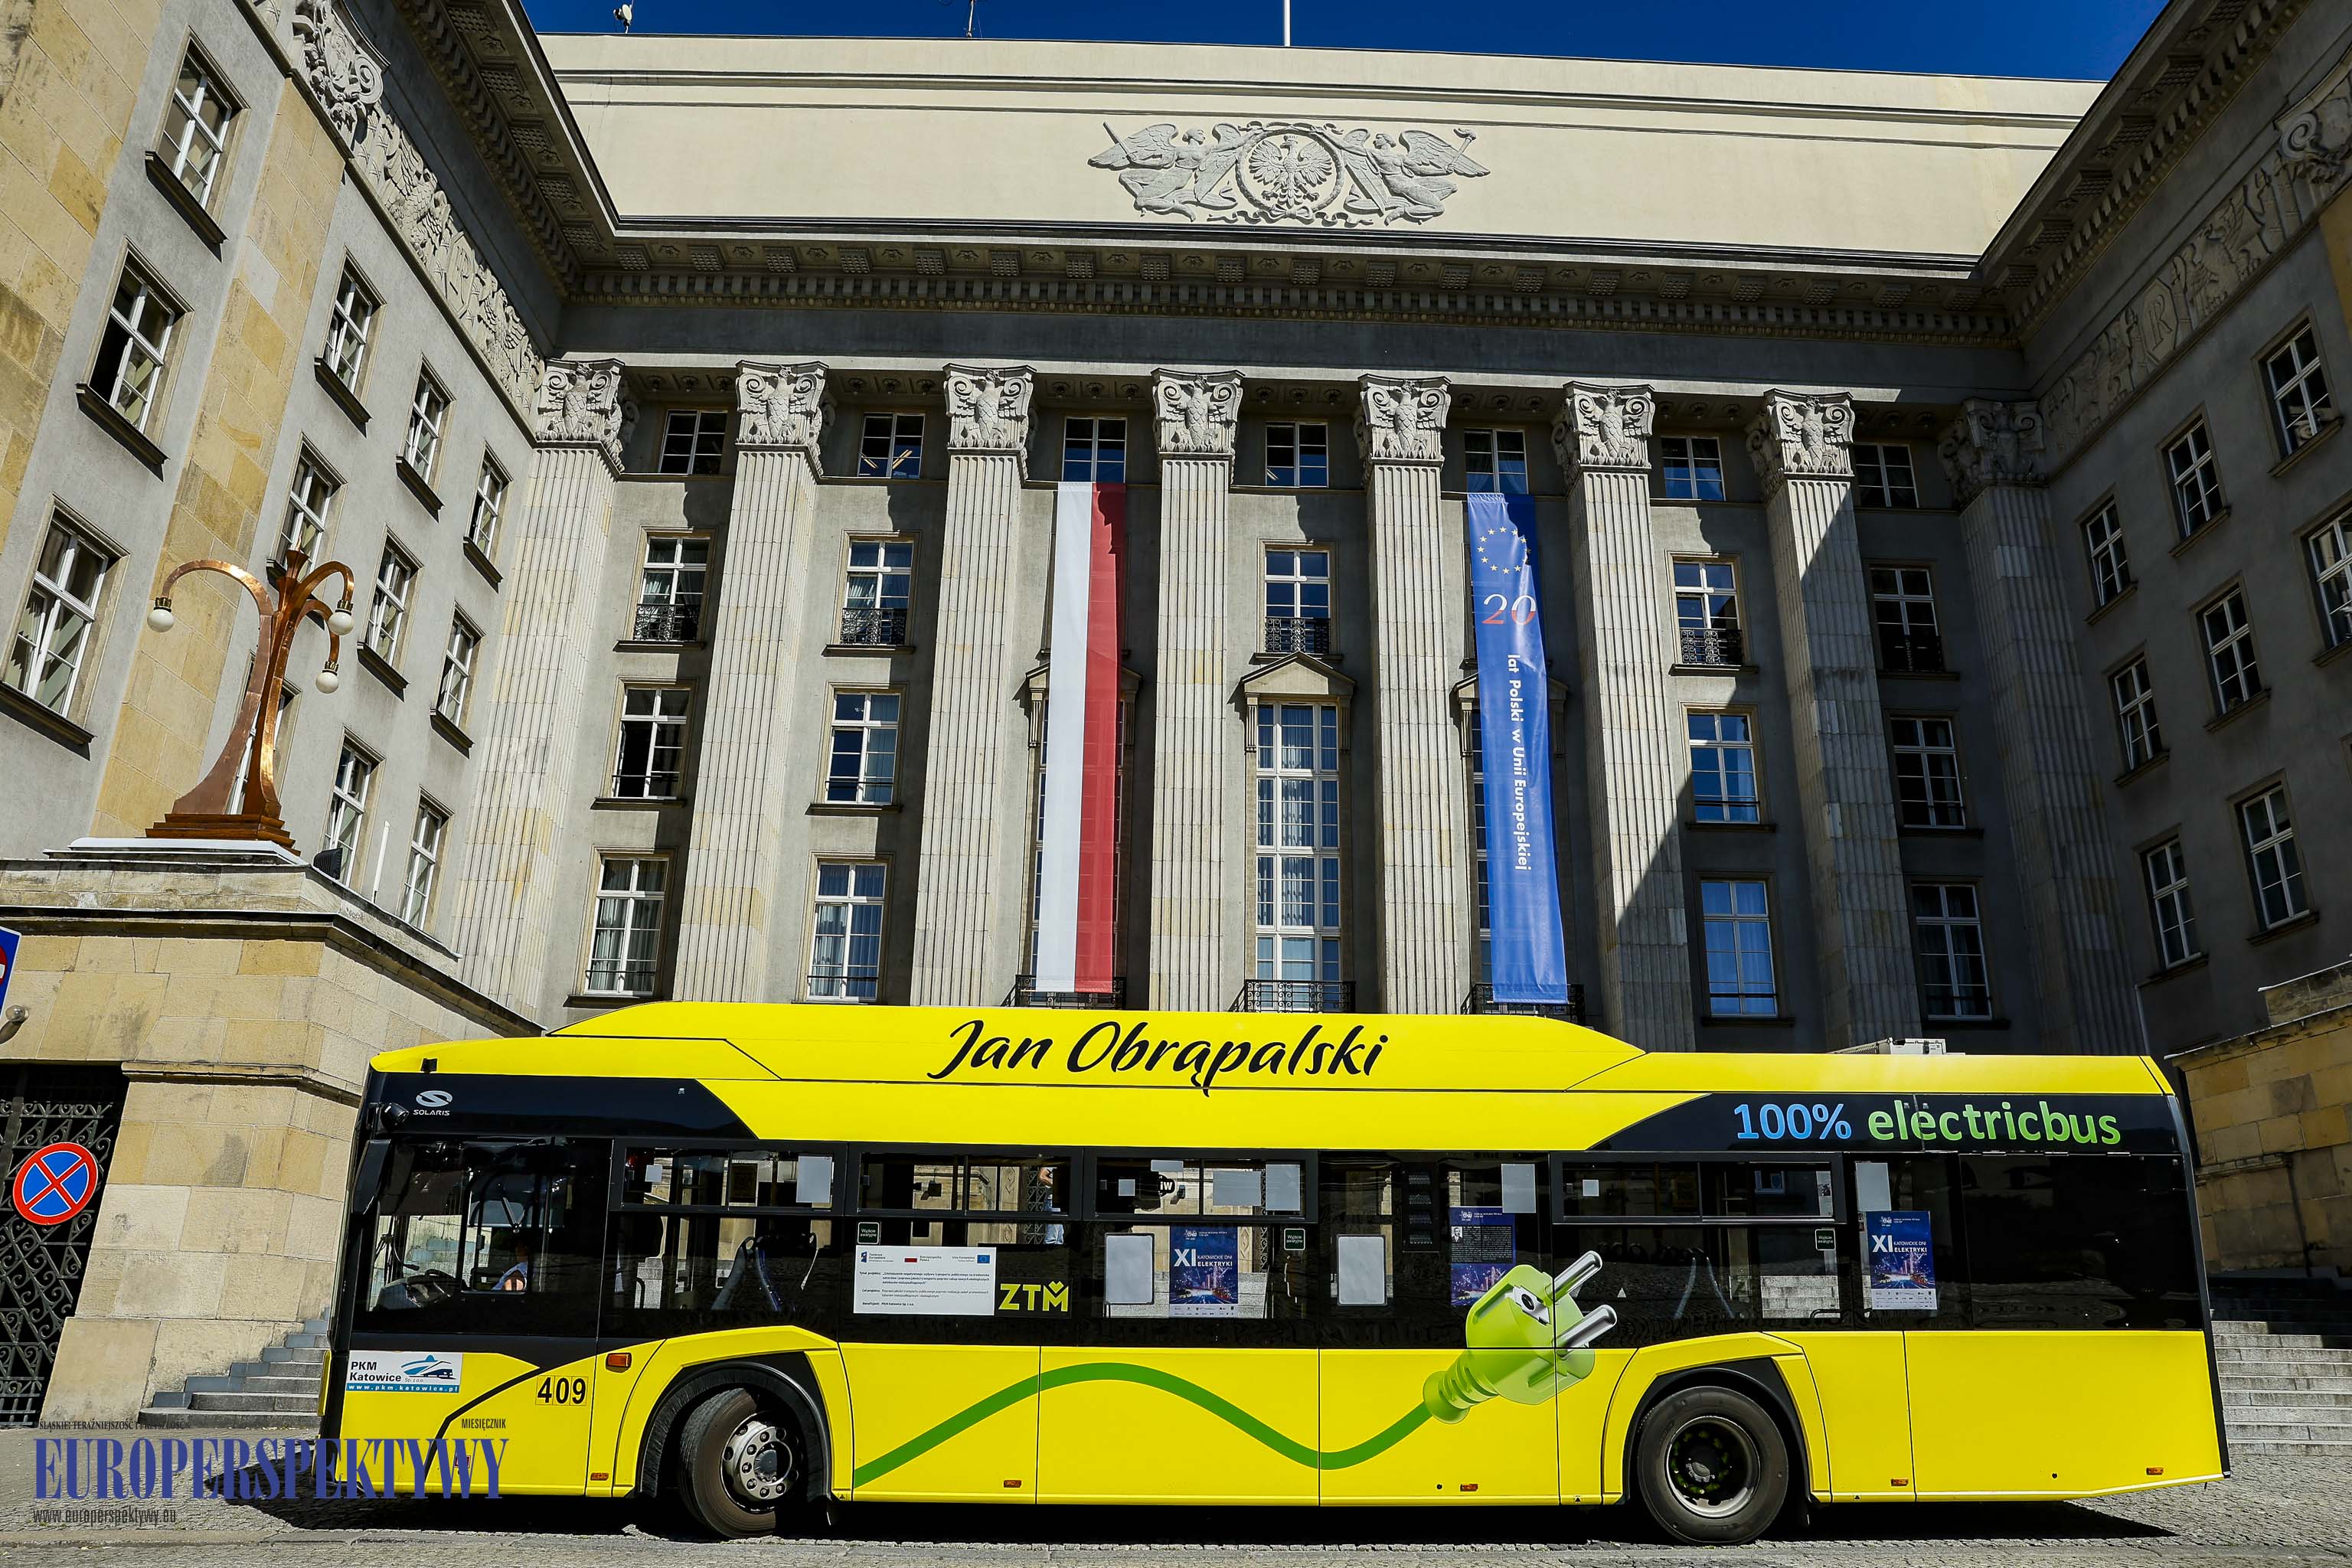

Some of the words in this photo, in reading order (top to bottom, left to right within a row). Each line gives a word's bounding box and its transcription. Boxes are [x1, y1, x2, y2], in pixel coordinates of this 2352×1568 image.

[1482, 593, 1537, 626] 20
[1508, 654, 1521, 673] lat
[1509, 680, 1524, 722] Polski
[1511, 728, 1521, 743] w
[1513, 747, 1527, 776] Unii
[1513, 779, 1532, 871] Europejskiej
[927, 1019, 1054, 1080] Jan
[1067, 1021, 1389, 1098] Obrąpalski
[1733, 1102, 1852, 1140] 100%
[1867, 1099, 2122, 1145] electricbus
[1174, 1249, 1196, 1267] XI
[1871, 1235, 1893, 1253] XI
[998, 1281, 1069, 1312] ZTM
[349, 1372, 402, 1382] Katowice
[351, 1361, 377, 1370] PKM
[537, 1377, 586, 1404] 409
